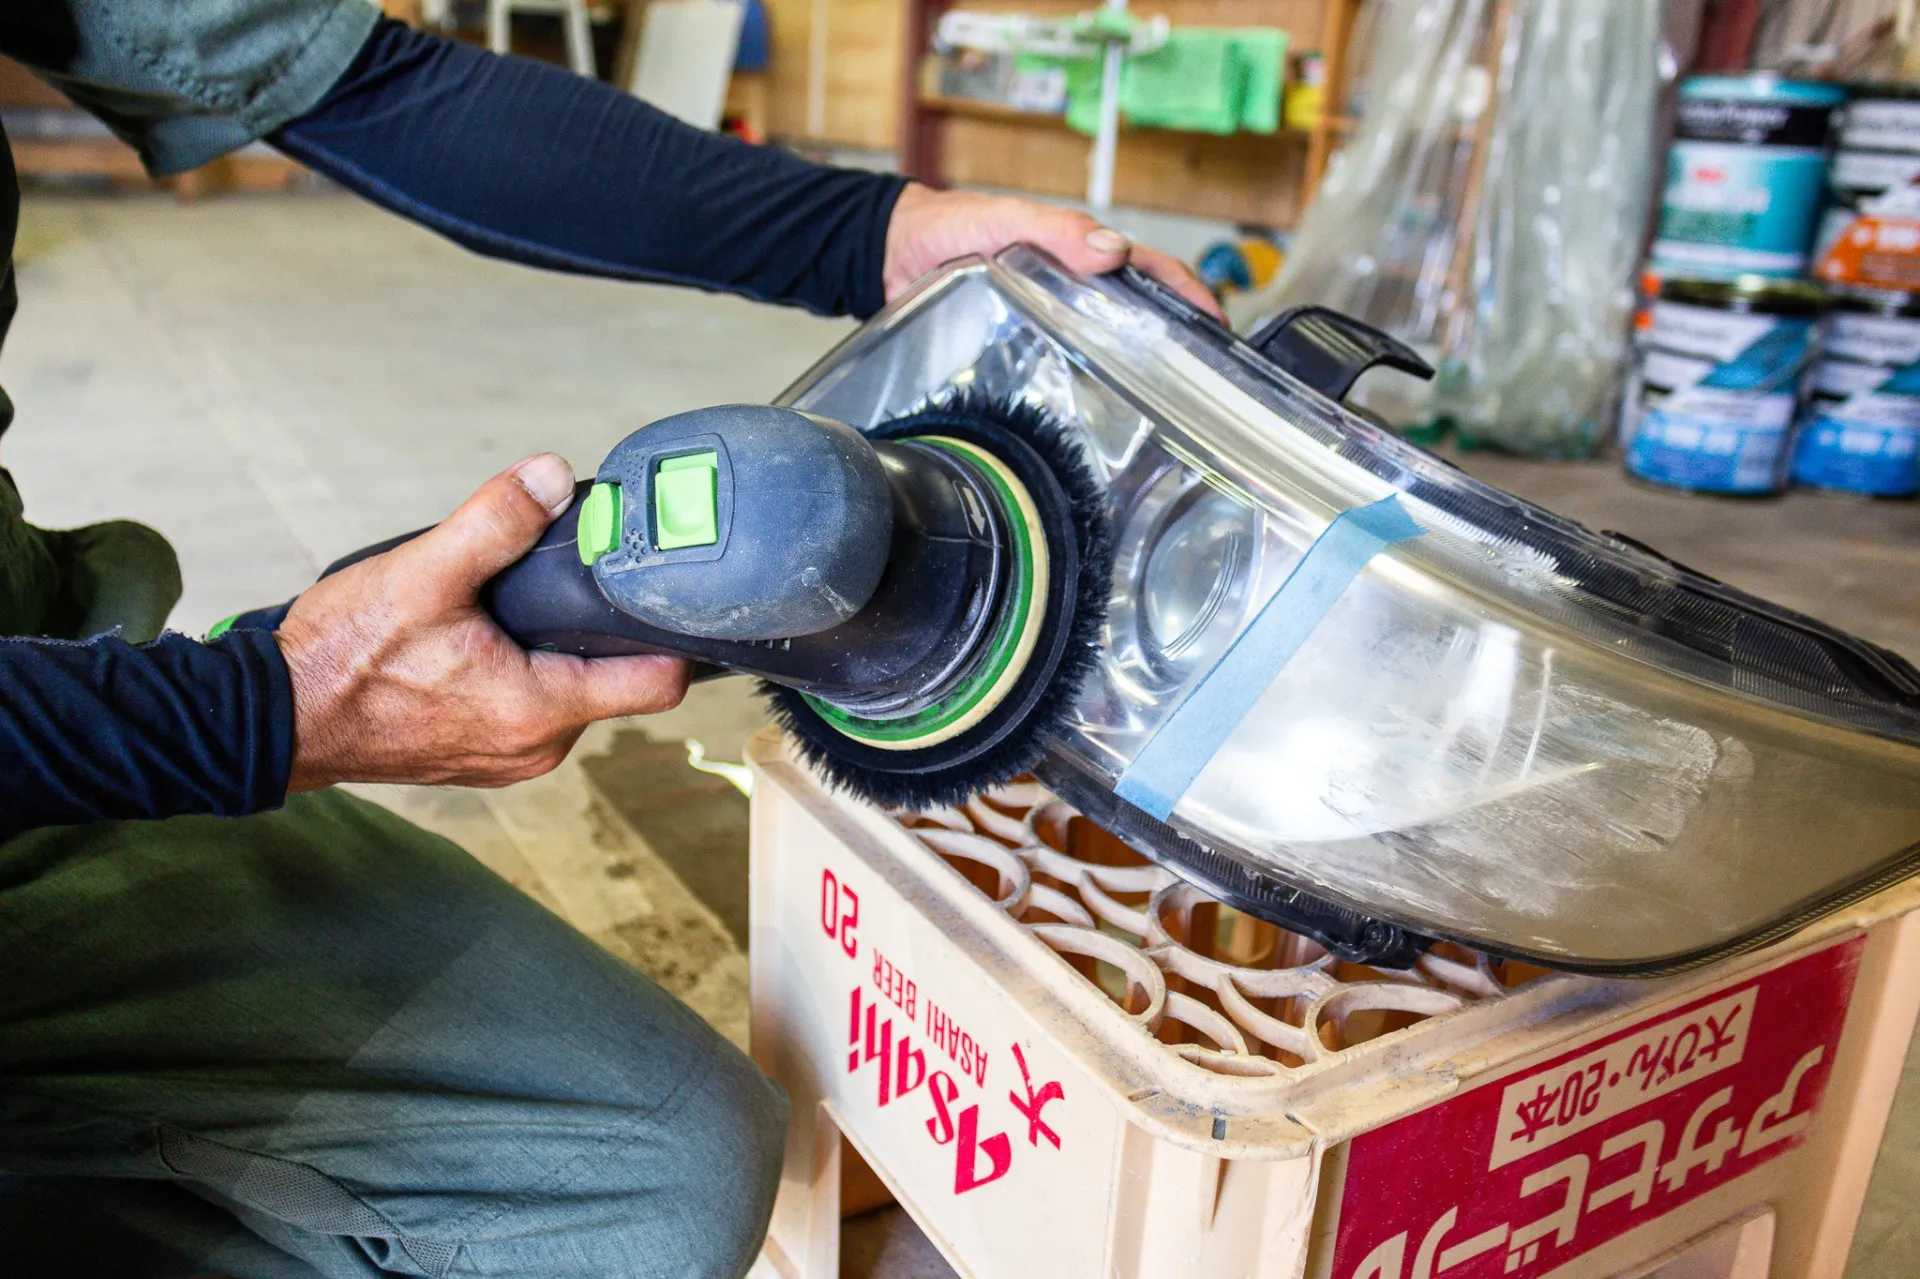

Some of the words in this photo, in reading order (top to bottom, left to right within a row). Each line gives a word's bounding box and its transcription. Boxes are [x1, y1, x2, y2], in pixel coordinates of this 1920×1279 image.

[821, 868, 859, 960] 20
[872, 949, 918, 1022] BEER
[847, 985, 1013, 1196] Asahi
[926, 1001, 989, 1088] ASAHI
[1008, 1042, 1066, 1151] 大
